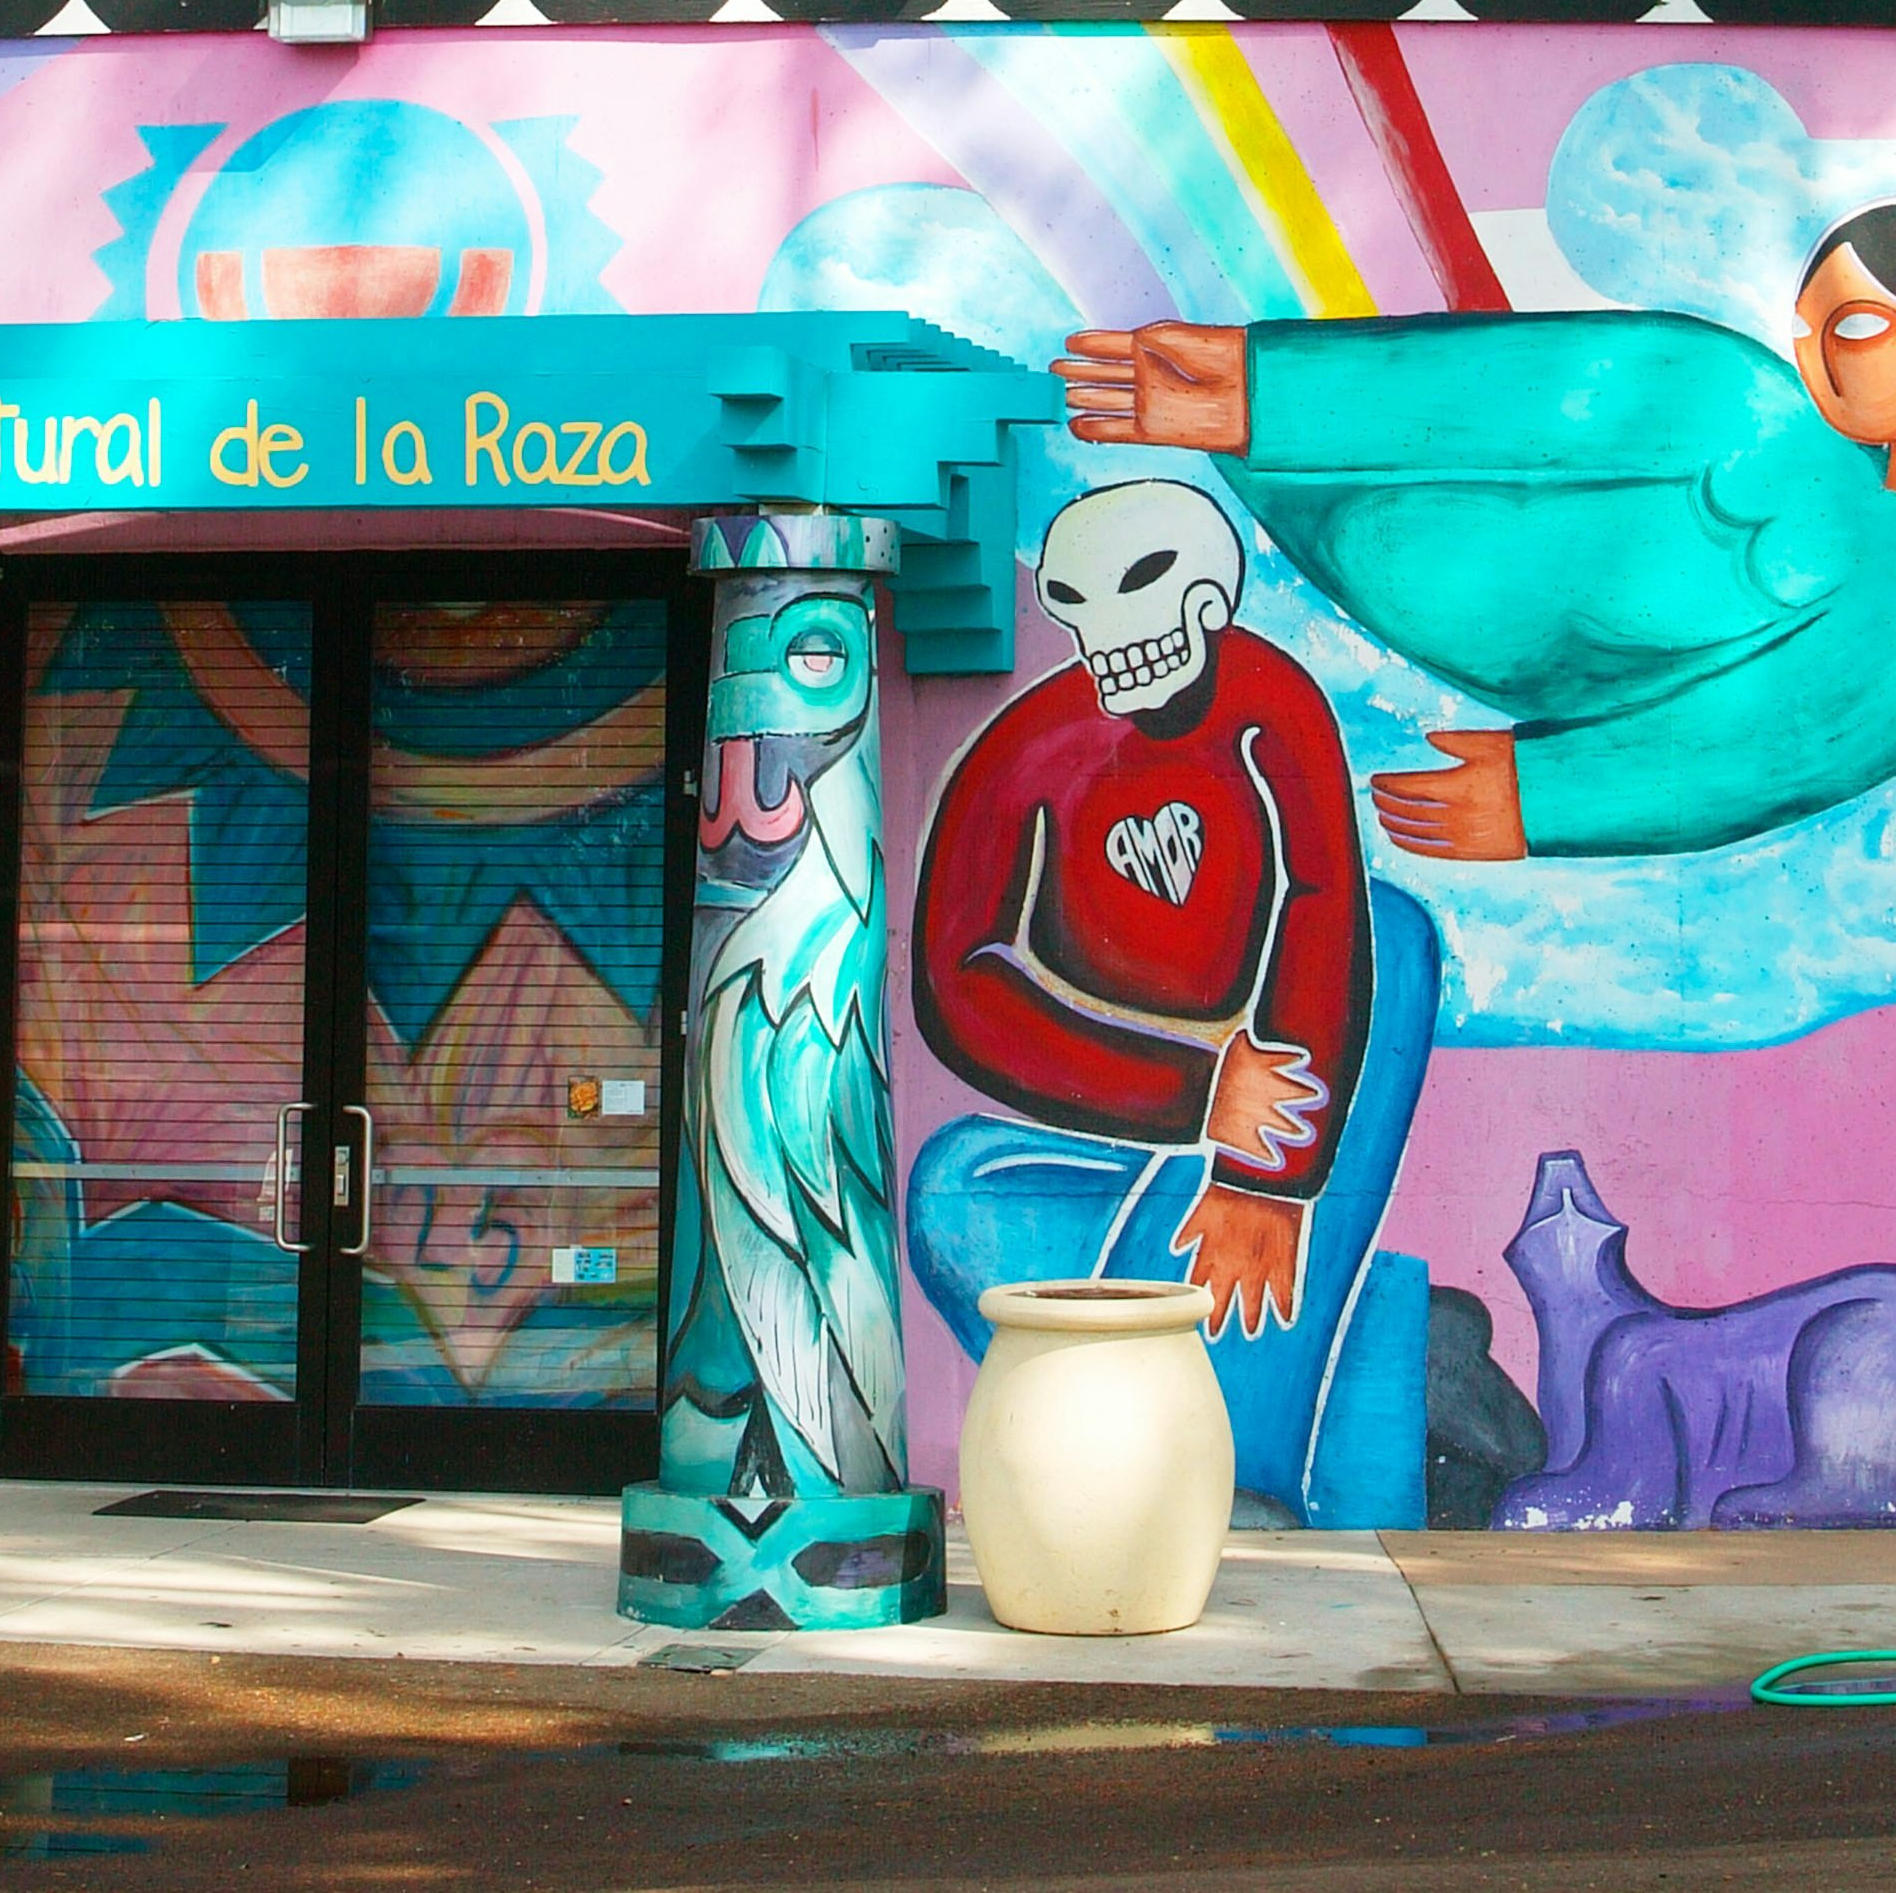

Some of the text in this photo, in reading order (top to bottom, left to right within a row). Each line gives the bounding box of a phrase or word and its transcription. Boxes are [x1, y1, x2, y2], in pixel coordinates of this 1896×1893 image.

[209, 397, 310, 489] de
[354, 395, 433, 487] la
[464, 391, 652, 487] Raza
[1106, 802, 1205, 907] AMOR
